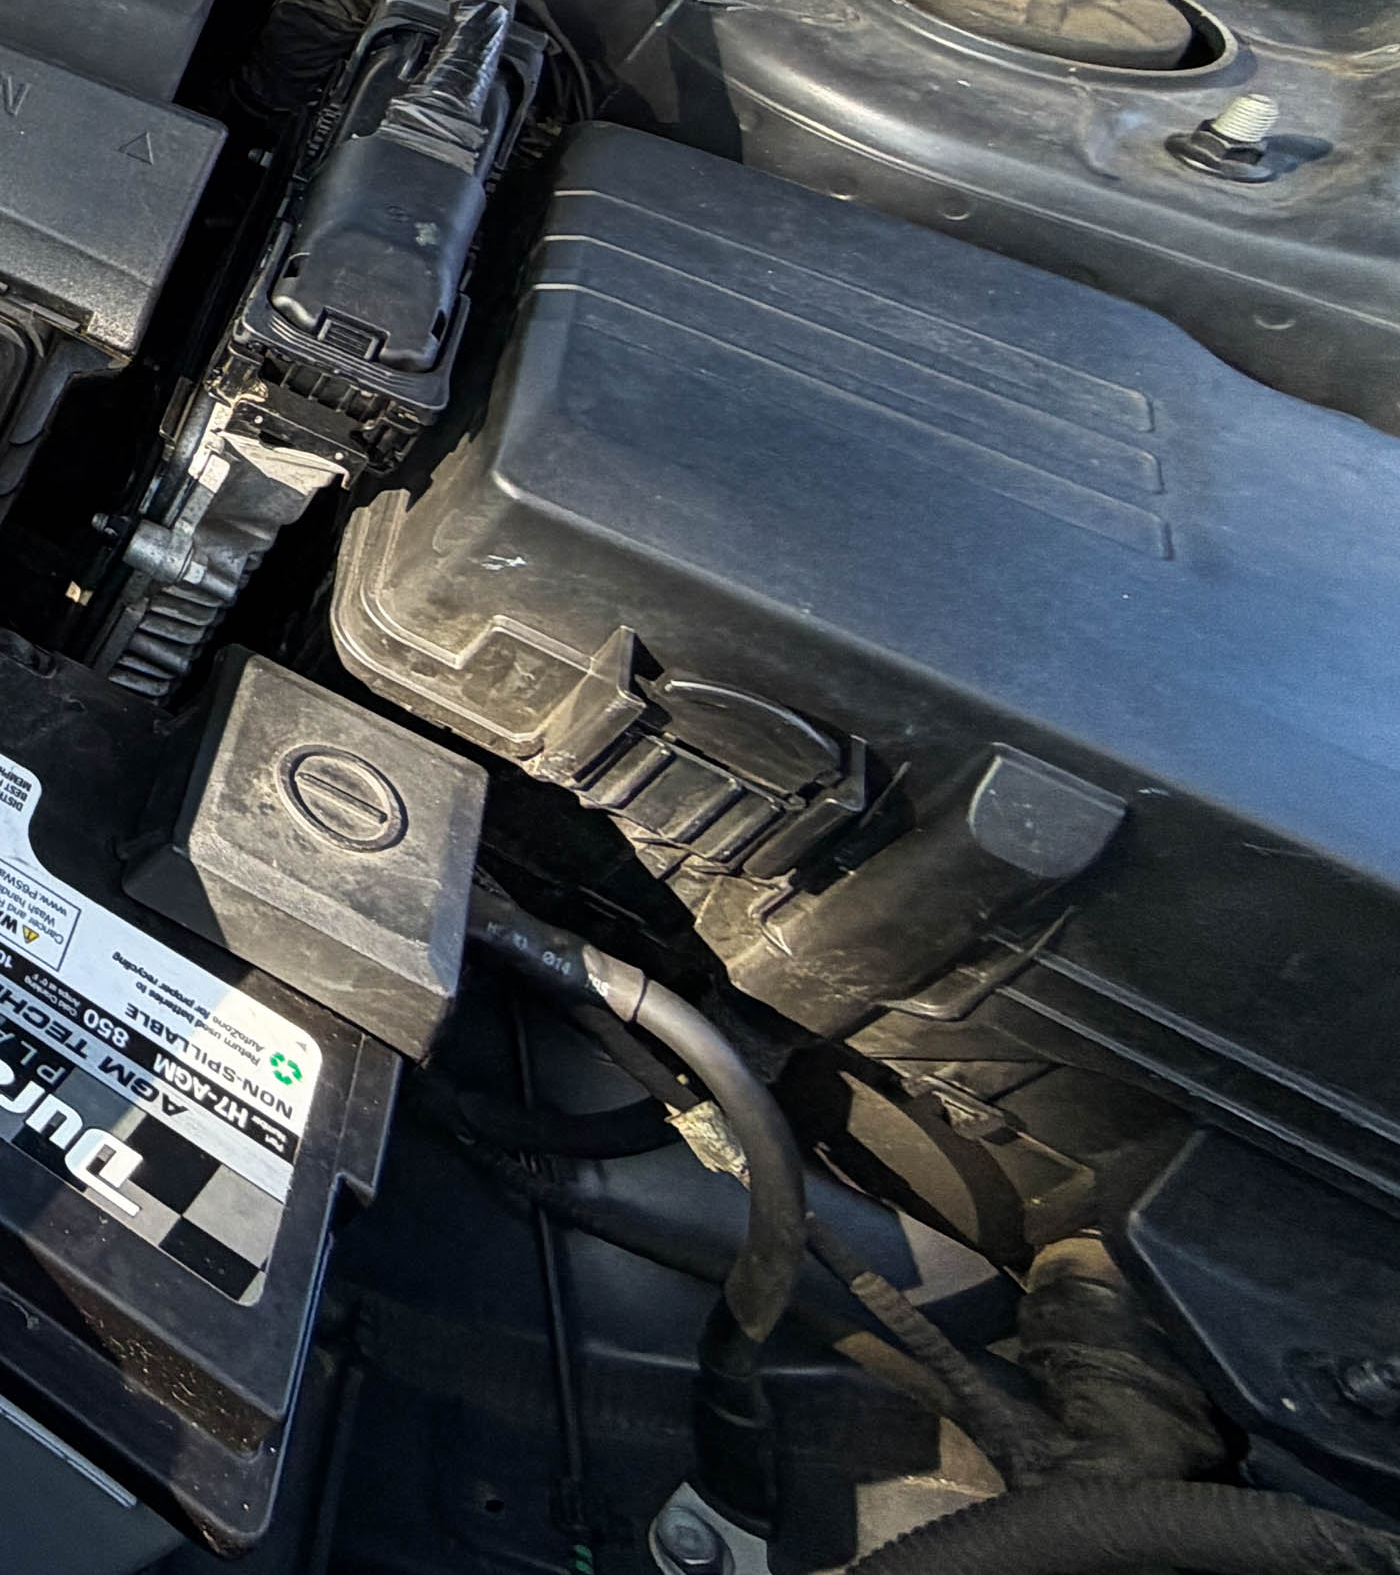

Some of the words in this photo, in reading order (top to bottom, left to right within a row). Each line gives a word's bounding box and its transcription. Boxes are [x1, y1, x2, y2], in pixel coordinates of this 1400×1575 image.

[3, 782, 27, 802] BEST
[5, 902, 26, 920] and
[26, 902, 55, 927] Wash
[27, 916, 64, 945] Cancer
[111, 950, 158, 985] recycling
[23, 974, 57, 1003] Cranking
[133, 980, 147, 993] to
[159, 980, 195, 1007] proper
[56, 999, 77, 1017] Cold
[146, 988, 194, 1023] batteries
[194, 1005, 210, 1019] for
[79, 1006, 130, 1049] 850
[194, 1018, 221, 1040] used
[210, 1015, 263, 1053] AutoZone
[123, 1001, 293, 1119] NON-SPILLABLE
[222, 1036, 259, 1065] Return
[97, 1054, 188, 1114] AGM
[150, 1052, 249, 1128] H7-AGM
